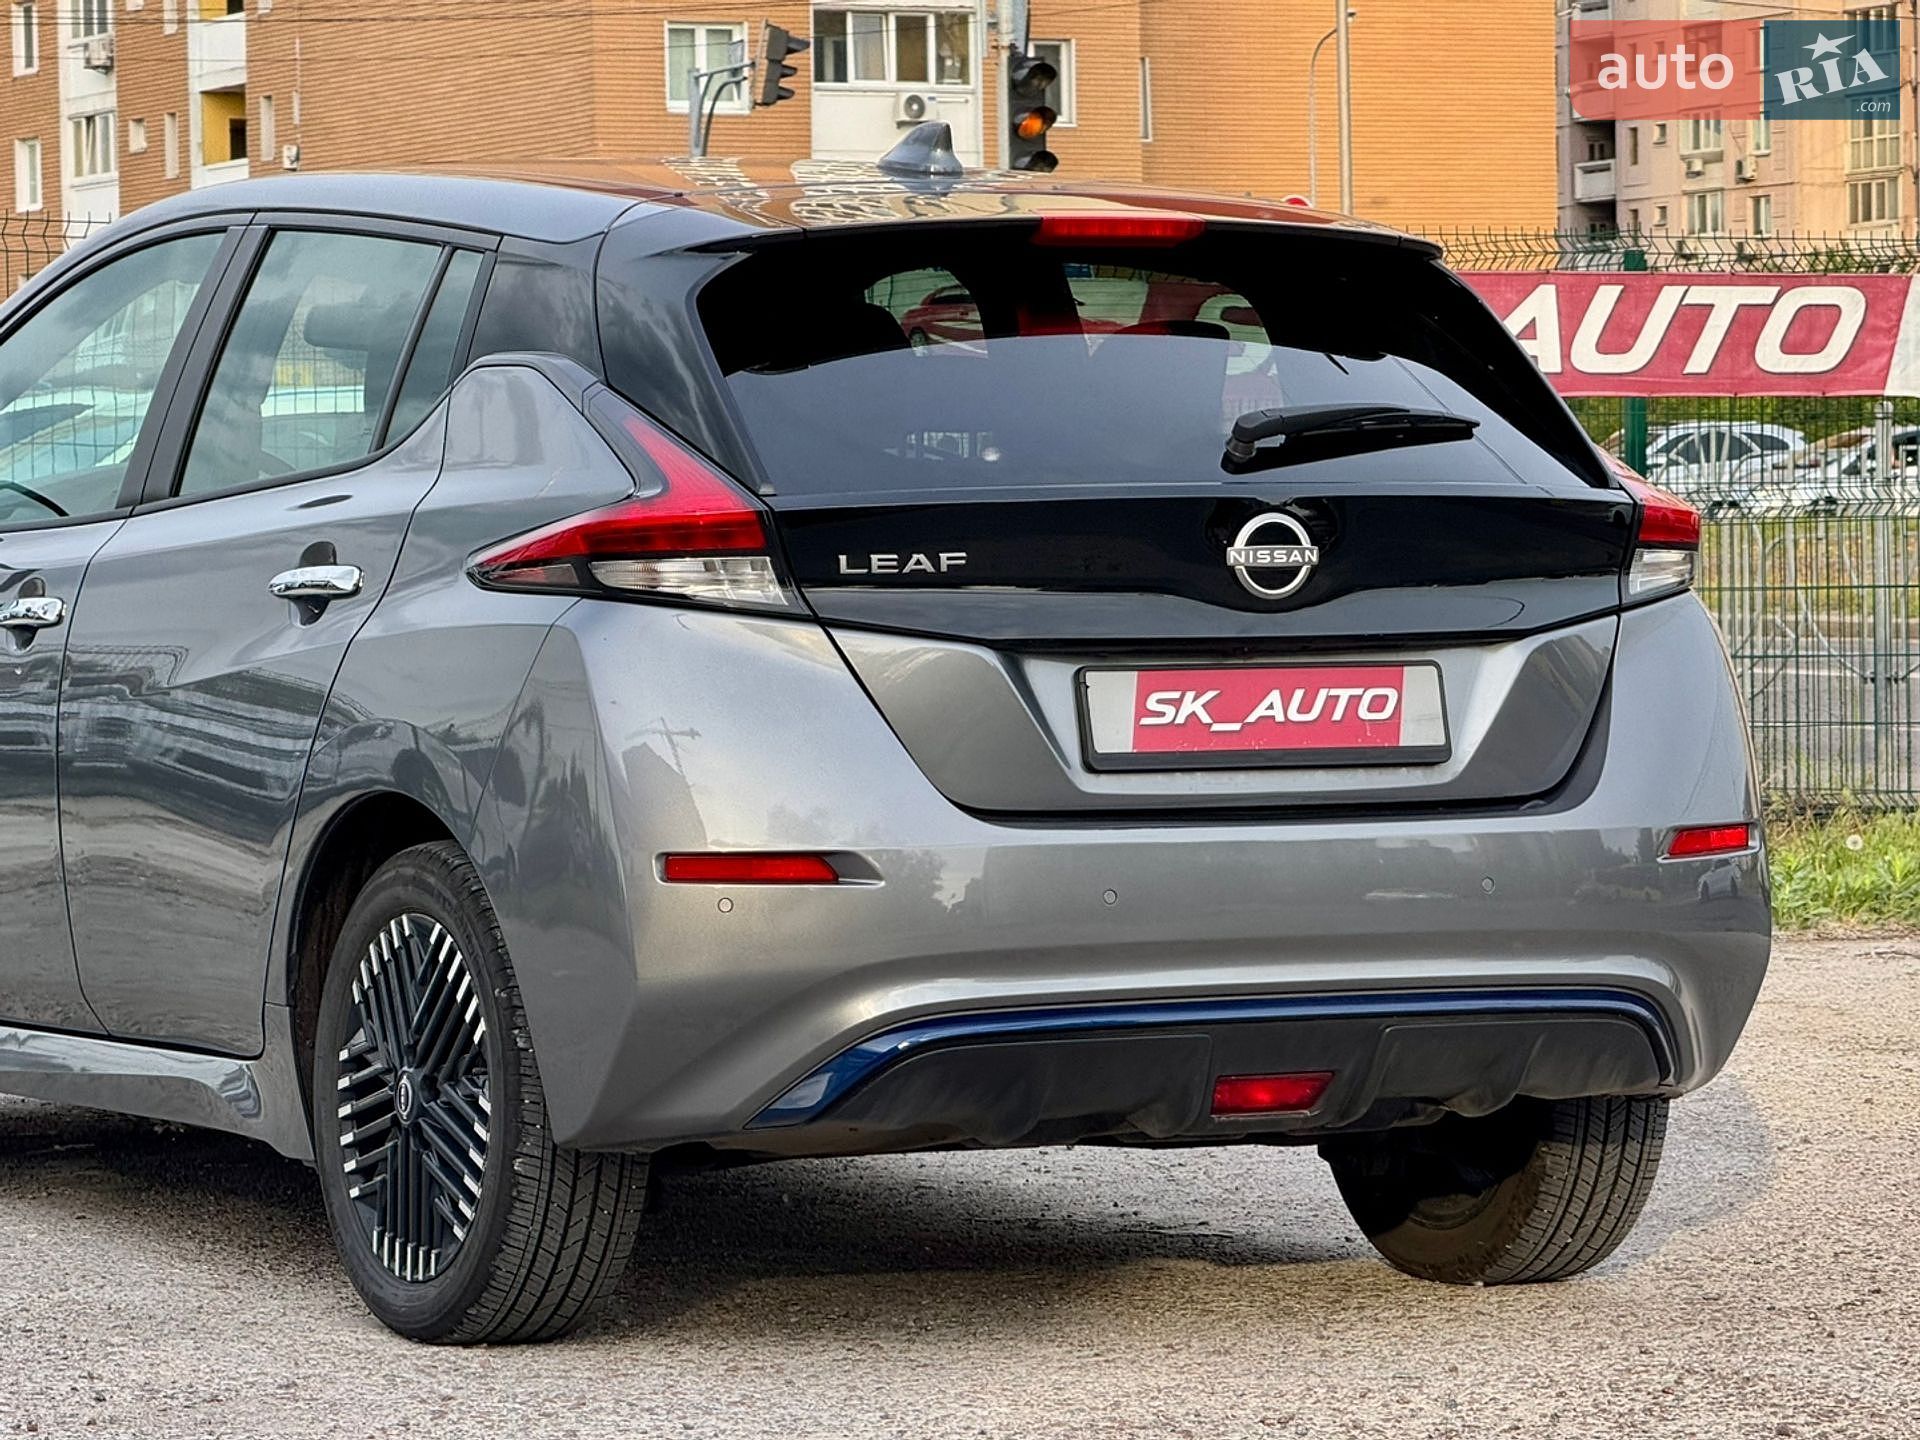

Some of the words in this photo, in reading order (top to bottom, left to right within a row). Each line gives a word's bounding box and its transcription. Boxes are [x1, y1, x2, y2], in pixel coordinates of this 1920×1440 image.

[838, 551, 968, 575] LEAF
[1229, 549, 1319, 565] NISSAN
[1138, 686, 1400, 733] SK_AUTO
